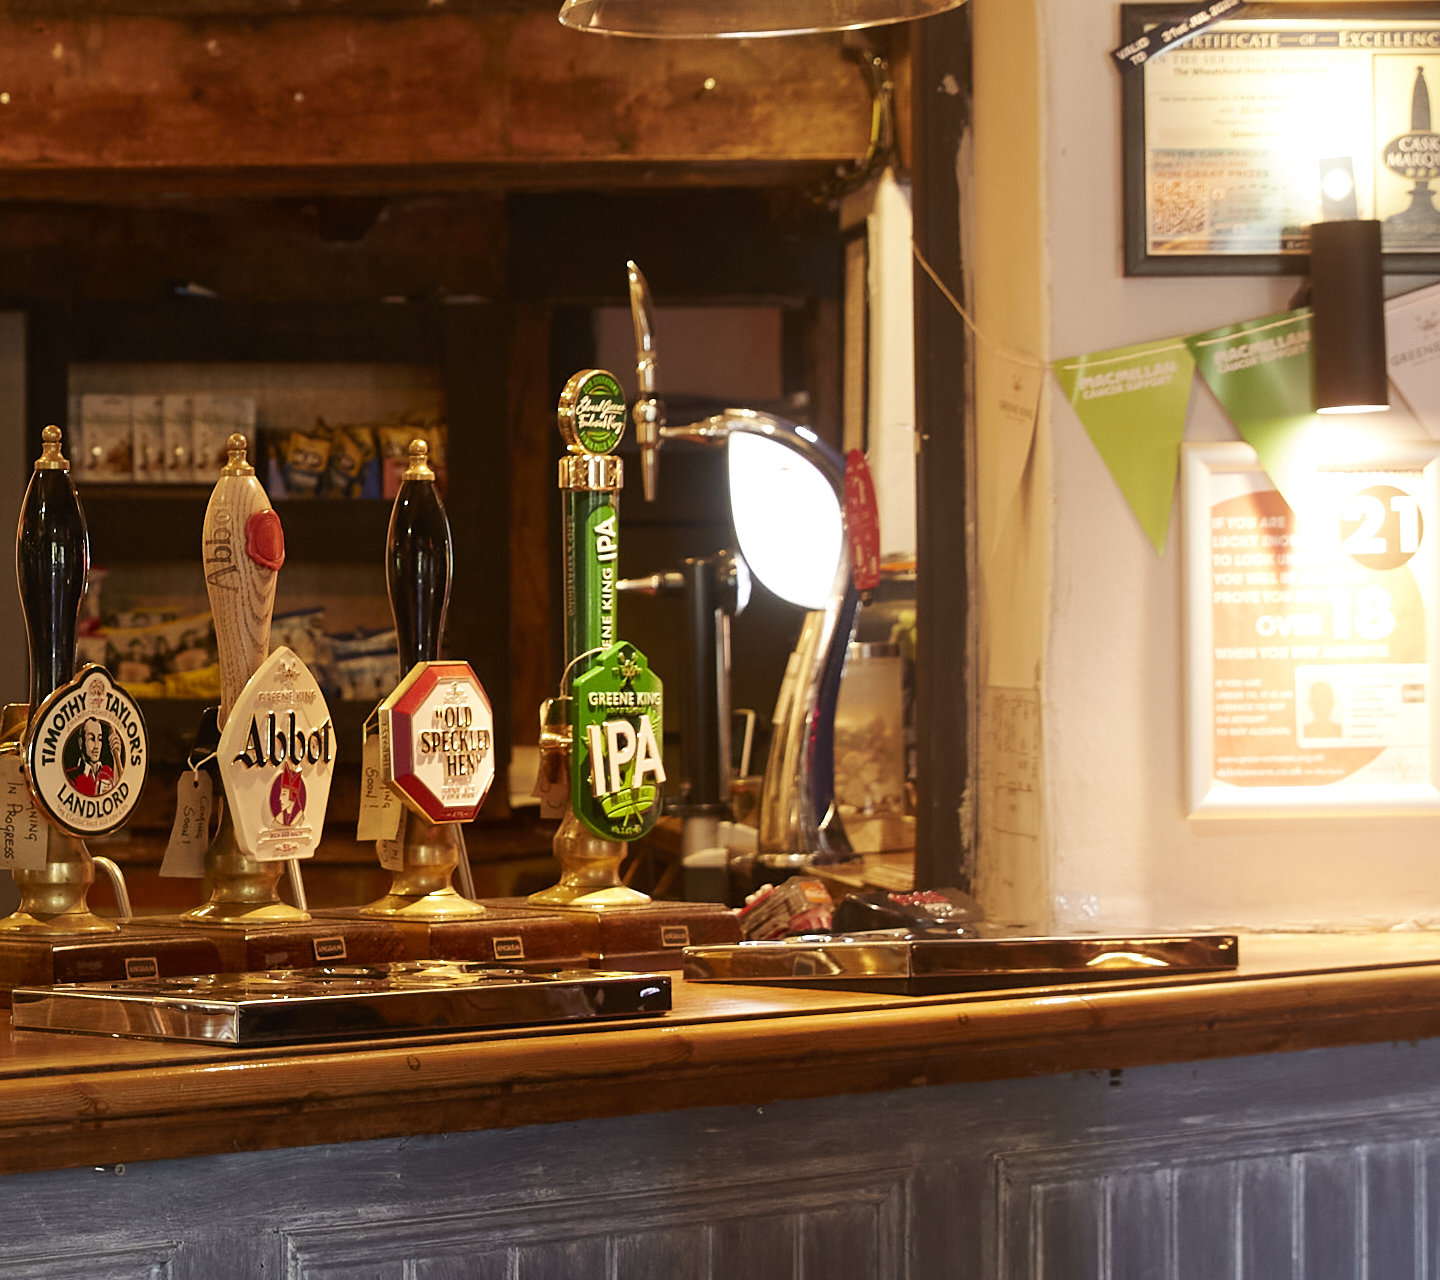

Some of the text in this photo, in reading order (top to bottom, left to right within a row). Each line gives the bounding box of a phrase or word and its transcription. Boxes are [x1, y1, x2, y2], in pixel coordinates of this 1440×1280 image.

[1181, 31, 1282, 49] ERTIFICATE
[1299, 33, 1317, 46] OF
[1078, 359, 1178, 392] MACMILLAN
[1082, 374, 1173, 402] CANCER SUPPORT
[1226, 516, 1258, 529] YOU
[1258, 516, 1287, 528] ARE
[1341, 495, 1420, 555] 21
[1212, 534, 1259, 548] LUCKY
[594, 515, 618, 613] KING IPA
[1212, 553, 1232, 567] TO
[1213, 571, 1244, 585] YOU
[1255, 585, 1397, 641] OVER 18
[1215, 647, 1256, 661] WHEN
[1257, 647, 1290, 660] YOU
[259, 690, 317, 705] GREENE KING
[588, 692, 661, 706] GREENE KING
[41, 691, 142, 768] TIMOTHY TAYLOR'S
[232, 708, 333, 770] Abbot
[420, 729, 491, 754] SPECKLED
[586, 714, 667, 798] IPA
[56, 781, 130, 819] LANDLORD
